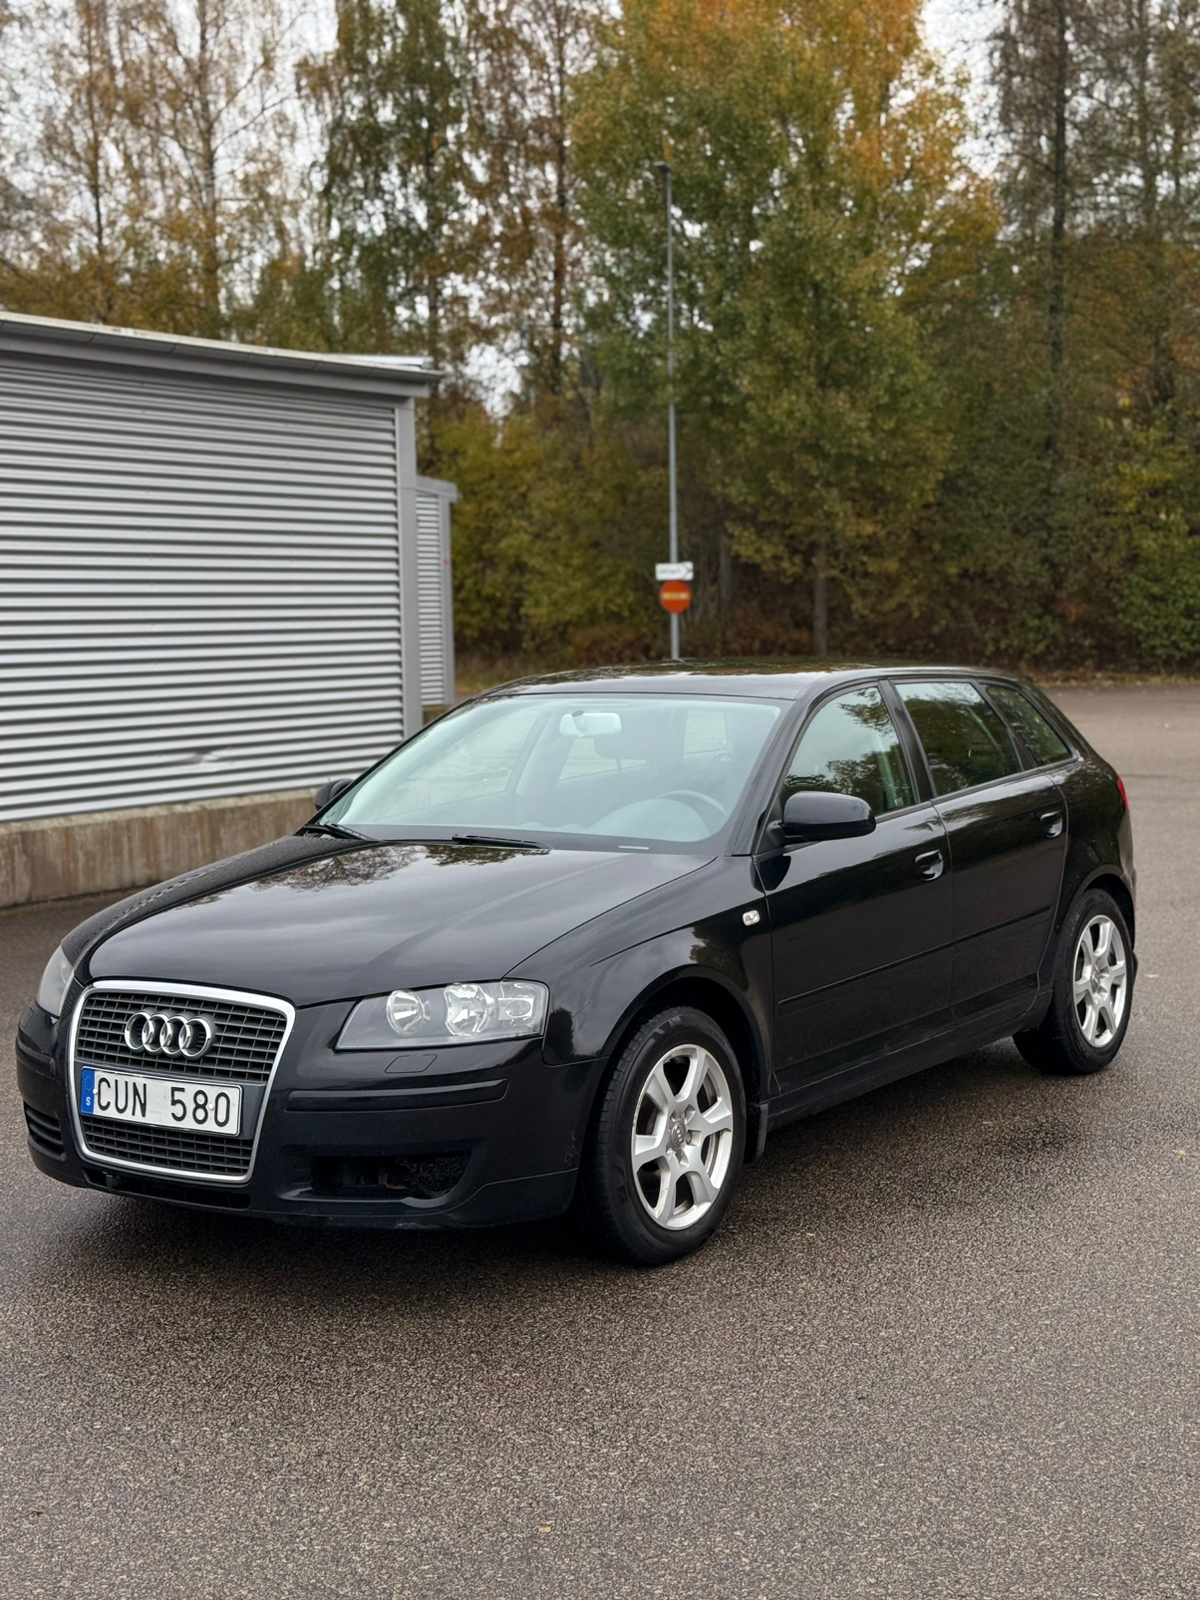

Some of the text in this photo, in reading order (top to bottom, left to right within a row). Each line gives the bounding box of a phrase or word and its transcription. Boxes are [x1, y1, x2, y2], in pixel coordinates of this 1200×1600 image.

[85, 1097, 91, 1106] S
[97, 1077, 231, 1127] CUN 580
